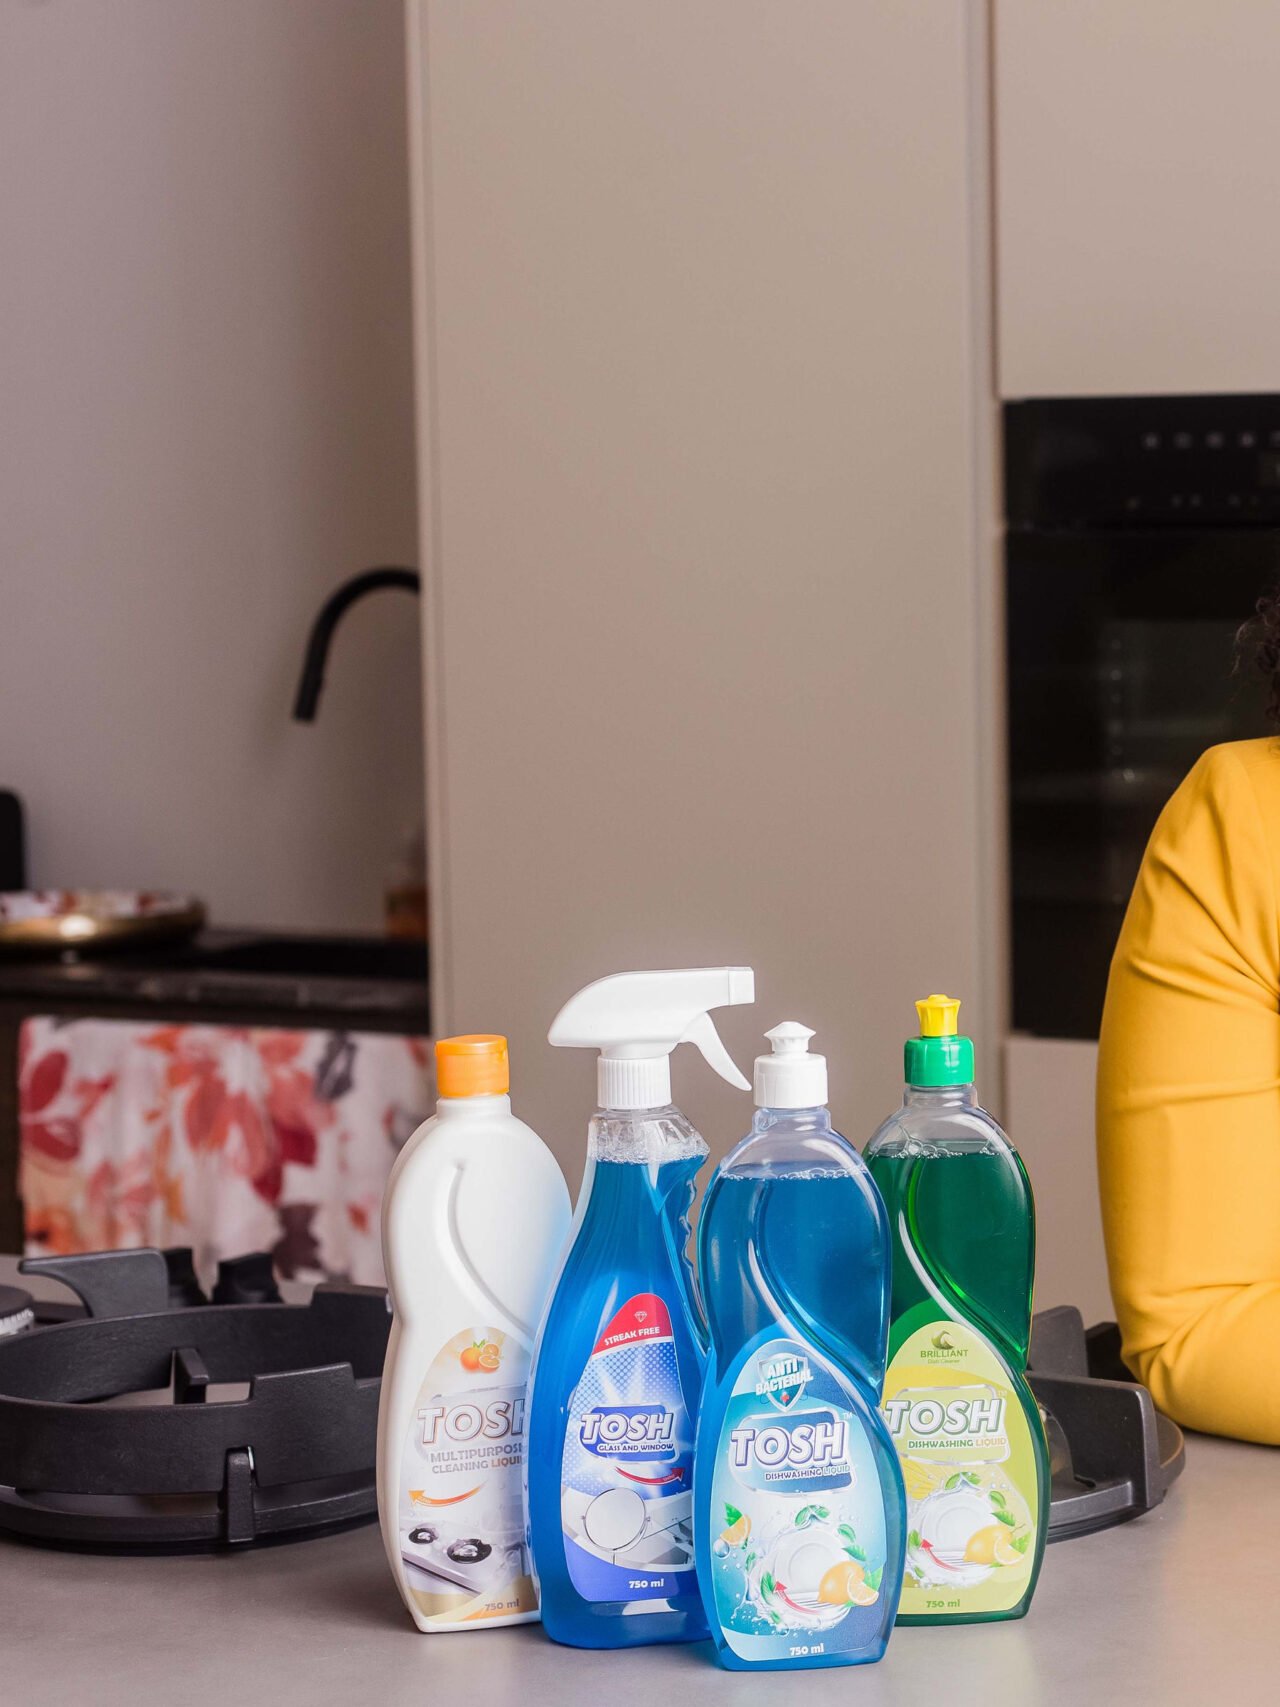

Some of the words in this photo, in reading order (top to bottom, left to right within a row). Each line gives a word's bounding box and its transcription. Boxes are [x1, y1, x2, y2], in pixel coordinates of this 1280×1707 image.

[604, 1330, 637, 1346] STREAK
[638, 1326, 660, 1337] FREE
[920, 1349, 968, 1358] BRILLIANT
[768, 1358, 799, 1379] ANTI
[755, 1368, 814, 1395] BACTERIAL
[885, 1398, 1002, 1435] TOSH
[581, 1412, 674, 1442] TOSH
[640, 1443, 674, 1451] WINDOW
[731, 1421, 846, 1467] TOSH
[908, 1439, 974, 1449] DISHWASHING
[976, 1437, 1007, 1447] LIQUID
[432, 1460, 489, 1474] CLEANING
[765, 1467, 822, 1481] DISHWASHING
[823, 1465, 851, 1475] LIQUID
[628, 1580, 648, 1589] 750
[650, 1578, 665, 1588] ml
[485, 1602, 503, 1611] 750
[506, 1598, 519, 1608] ml
[926, 1600, 945, 1608] 750
[947, 1599, 961, 1608] ml
[789, 1645, 809, 1656] 750
[810, 1642, 825, 1654] ml
